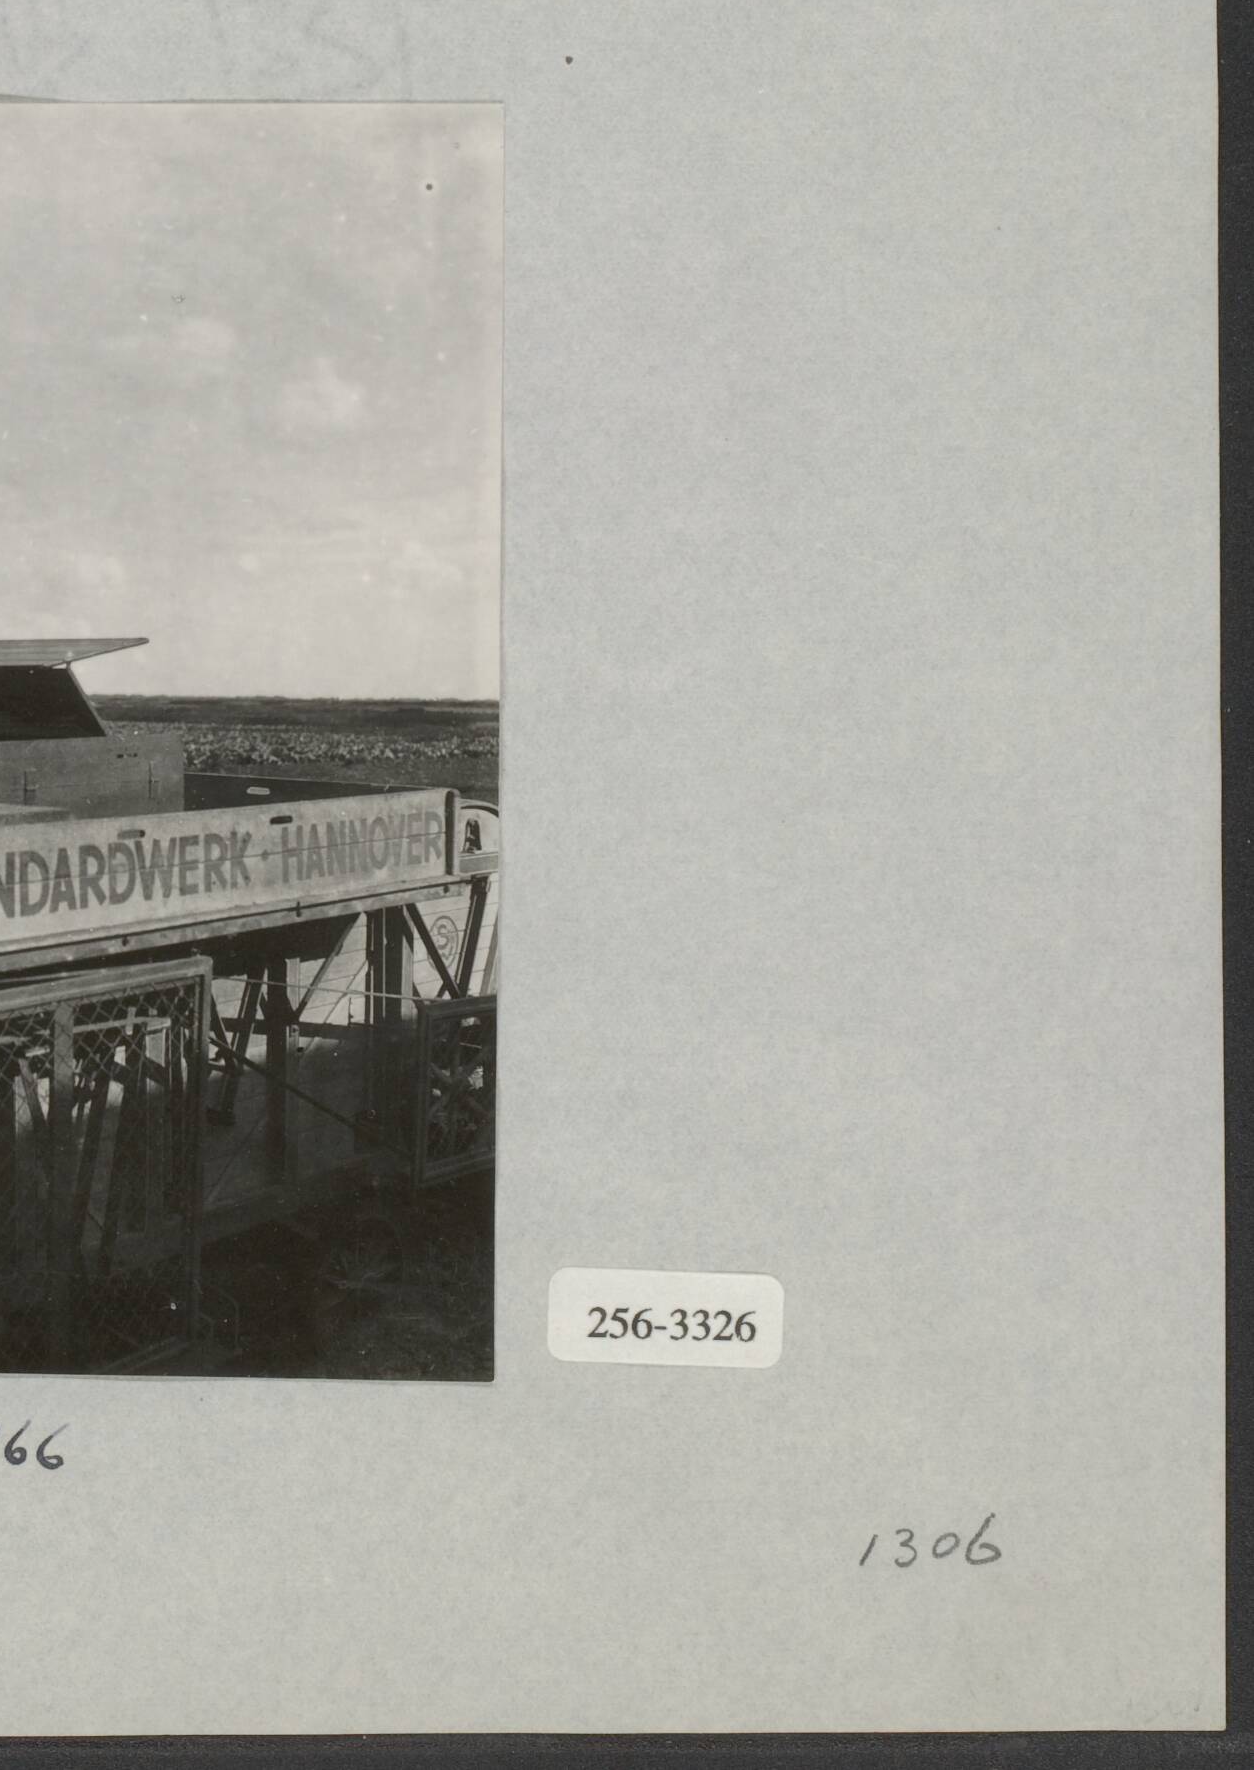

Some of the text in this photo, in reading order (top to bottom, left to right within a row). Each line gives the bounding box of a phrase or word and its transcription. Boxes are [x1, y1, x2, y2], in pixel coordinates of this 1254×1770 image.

[281, 810, 444, 884] HANNOVER
[586, 1306, 757, 1343] 256-3326
[859, 1512, 1002, 1569] 1306
